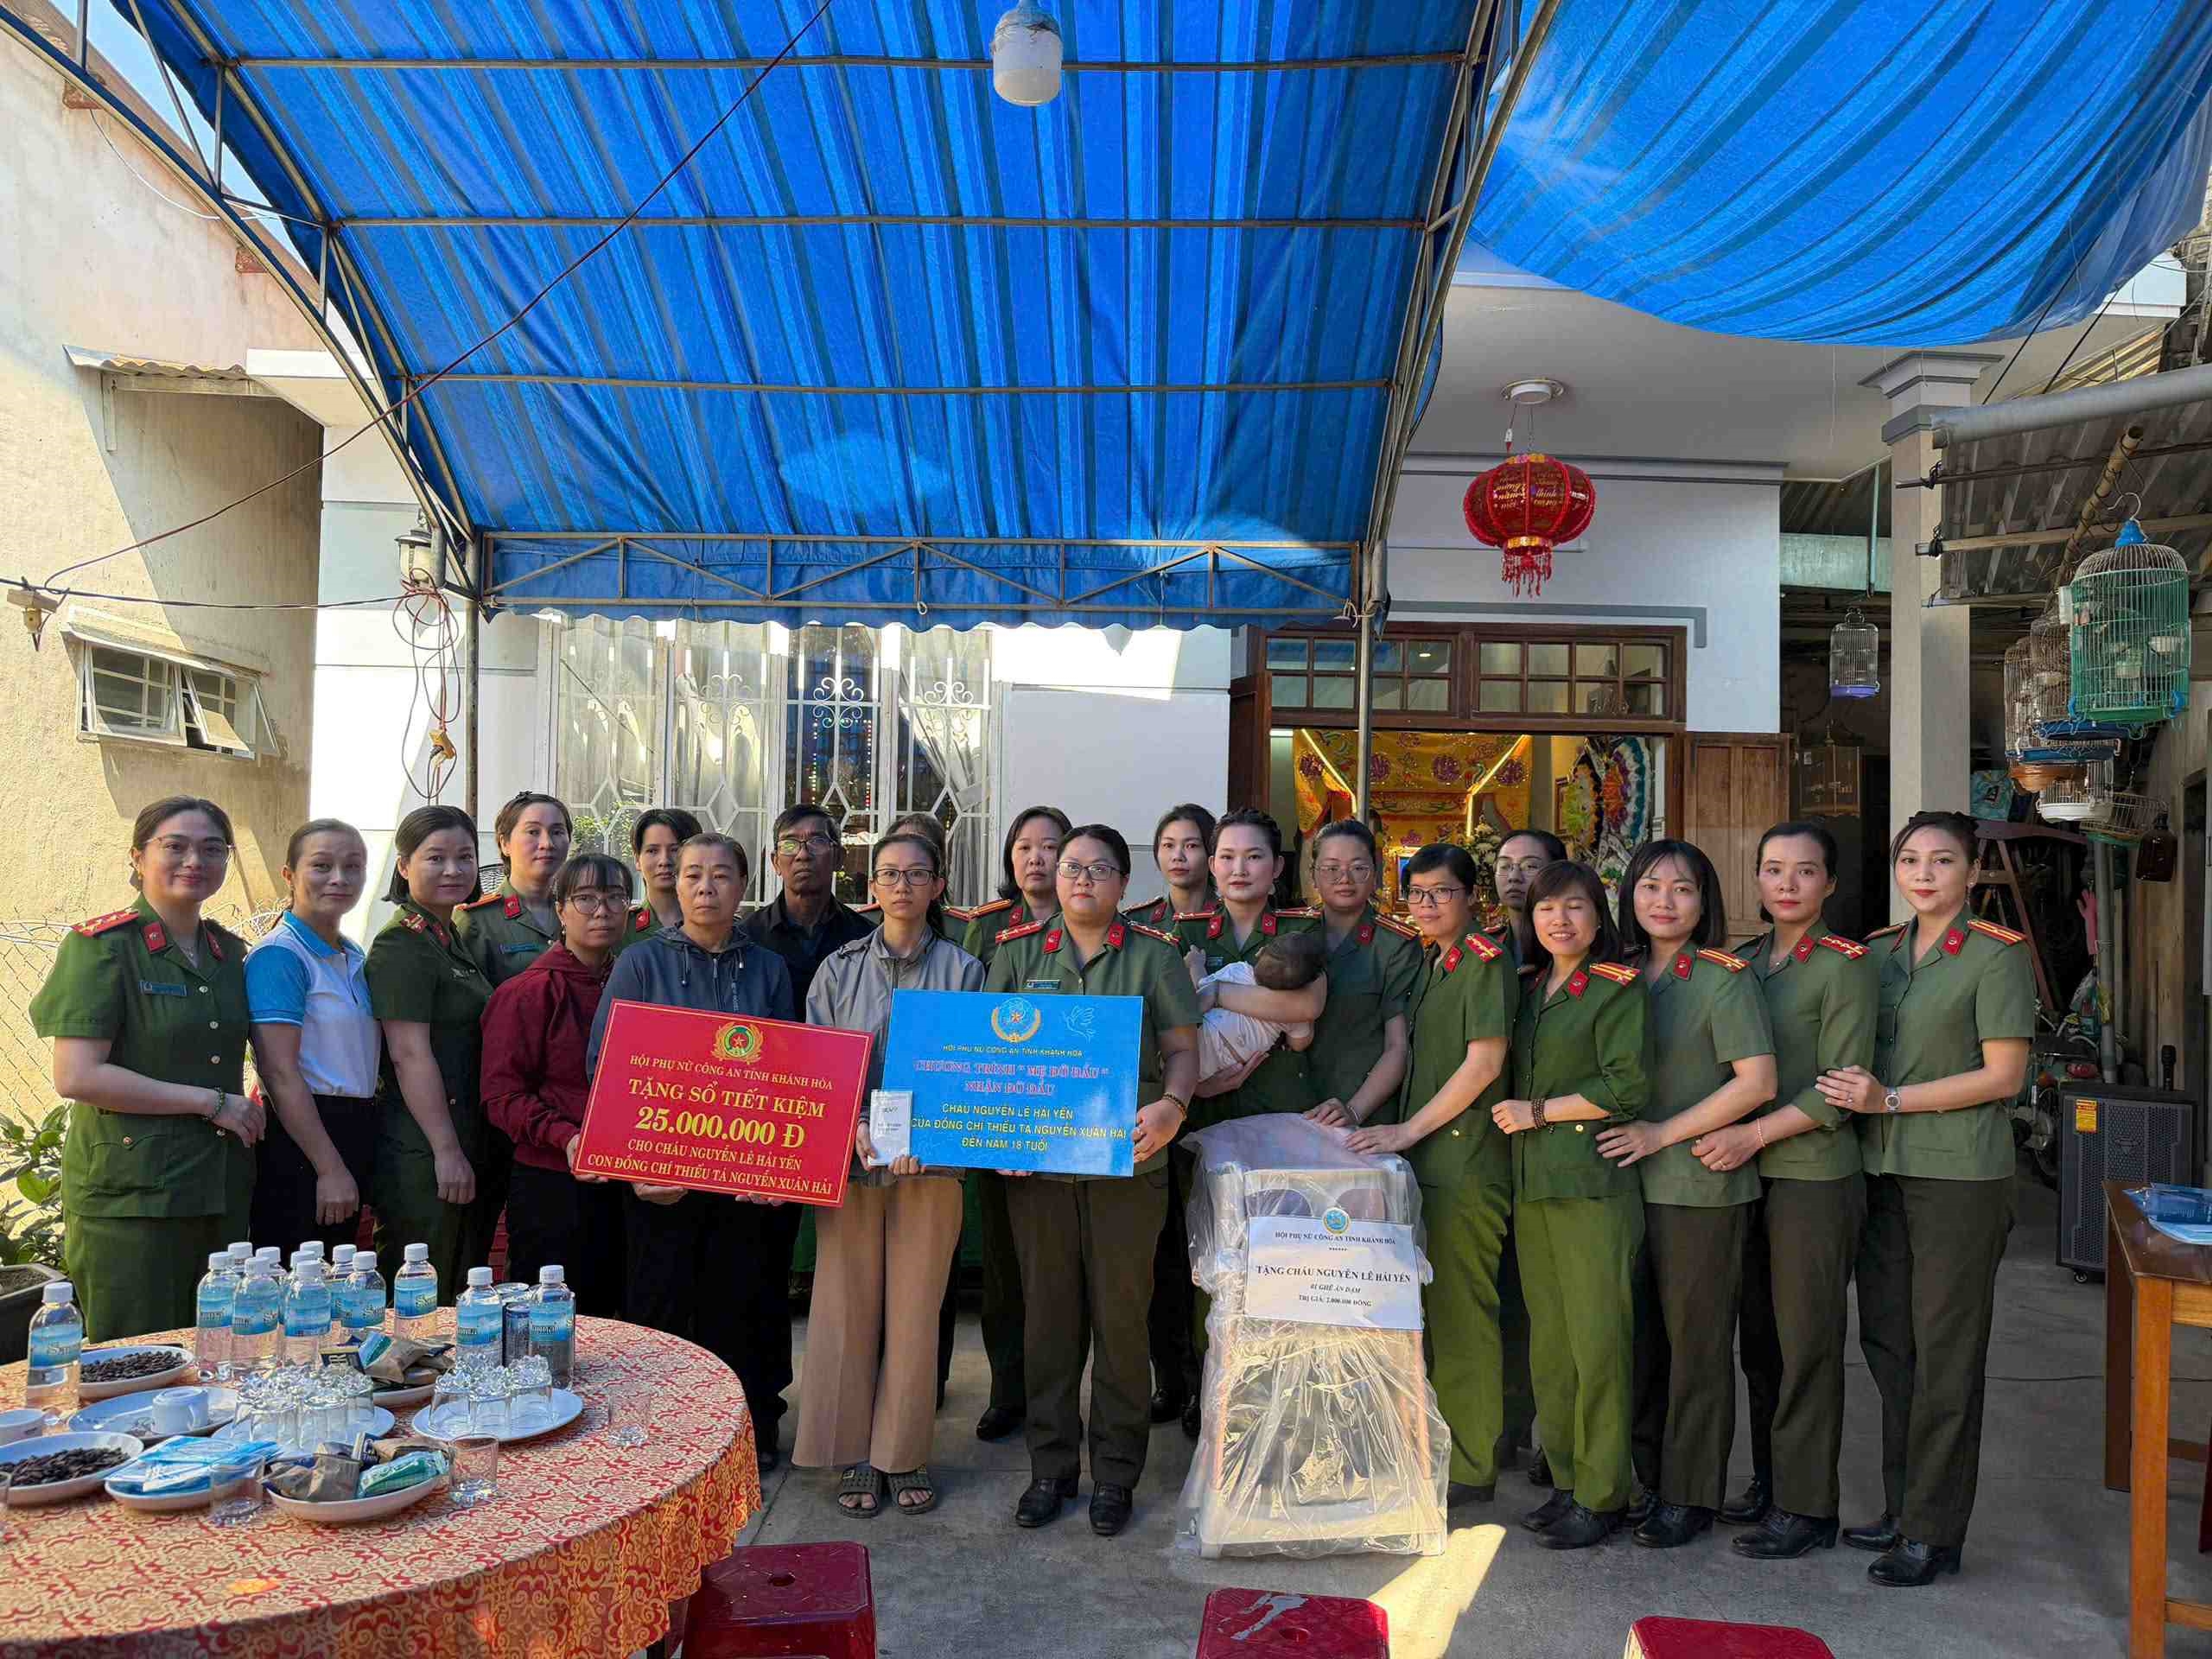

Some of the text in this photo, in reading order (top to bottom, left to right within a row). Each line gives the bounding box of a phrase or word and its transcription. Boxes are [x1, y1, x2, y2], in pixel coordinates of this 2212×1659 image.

[630, 1055, 650, 1067] HỘI
[652, 1058, 674, 1071] PHỤ
[695, 1061, 724, 1076] CÔNG
[726, 1066, 742, 1078] AN
[772, 1071, 810, 1087] KHÁNH
[628, 1077, 825, 1119] TẶNG SỔ TIẾT KIỆM
[635, 1106, 805, 1148] 25.000.000 Đ
[627, 1138, 652, 1152] CHO
[655, 1140, 688, 1156] CHÁU
[587, 1154, 613, 1167] CON
[1255, 1265, 1285, 1276] TẶNG
[1286, 1266, 1315, 1277] CHÁU
[1361, 1270, 1374, 1282] LÊ
